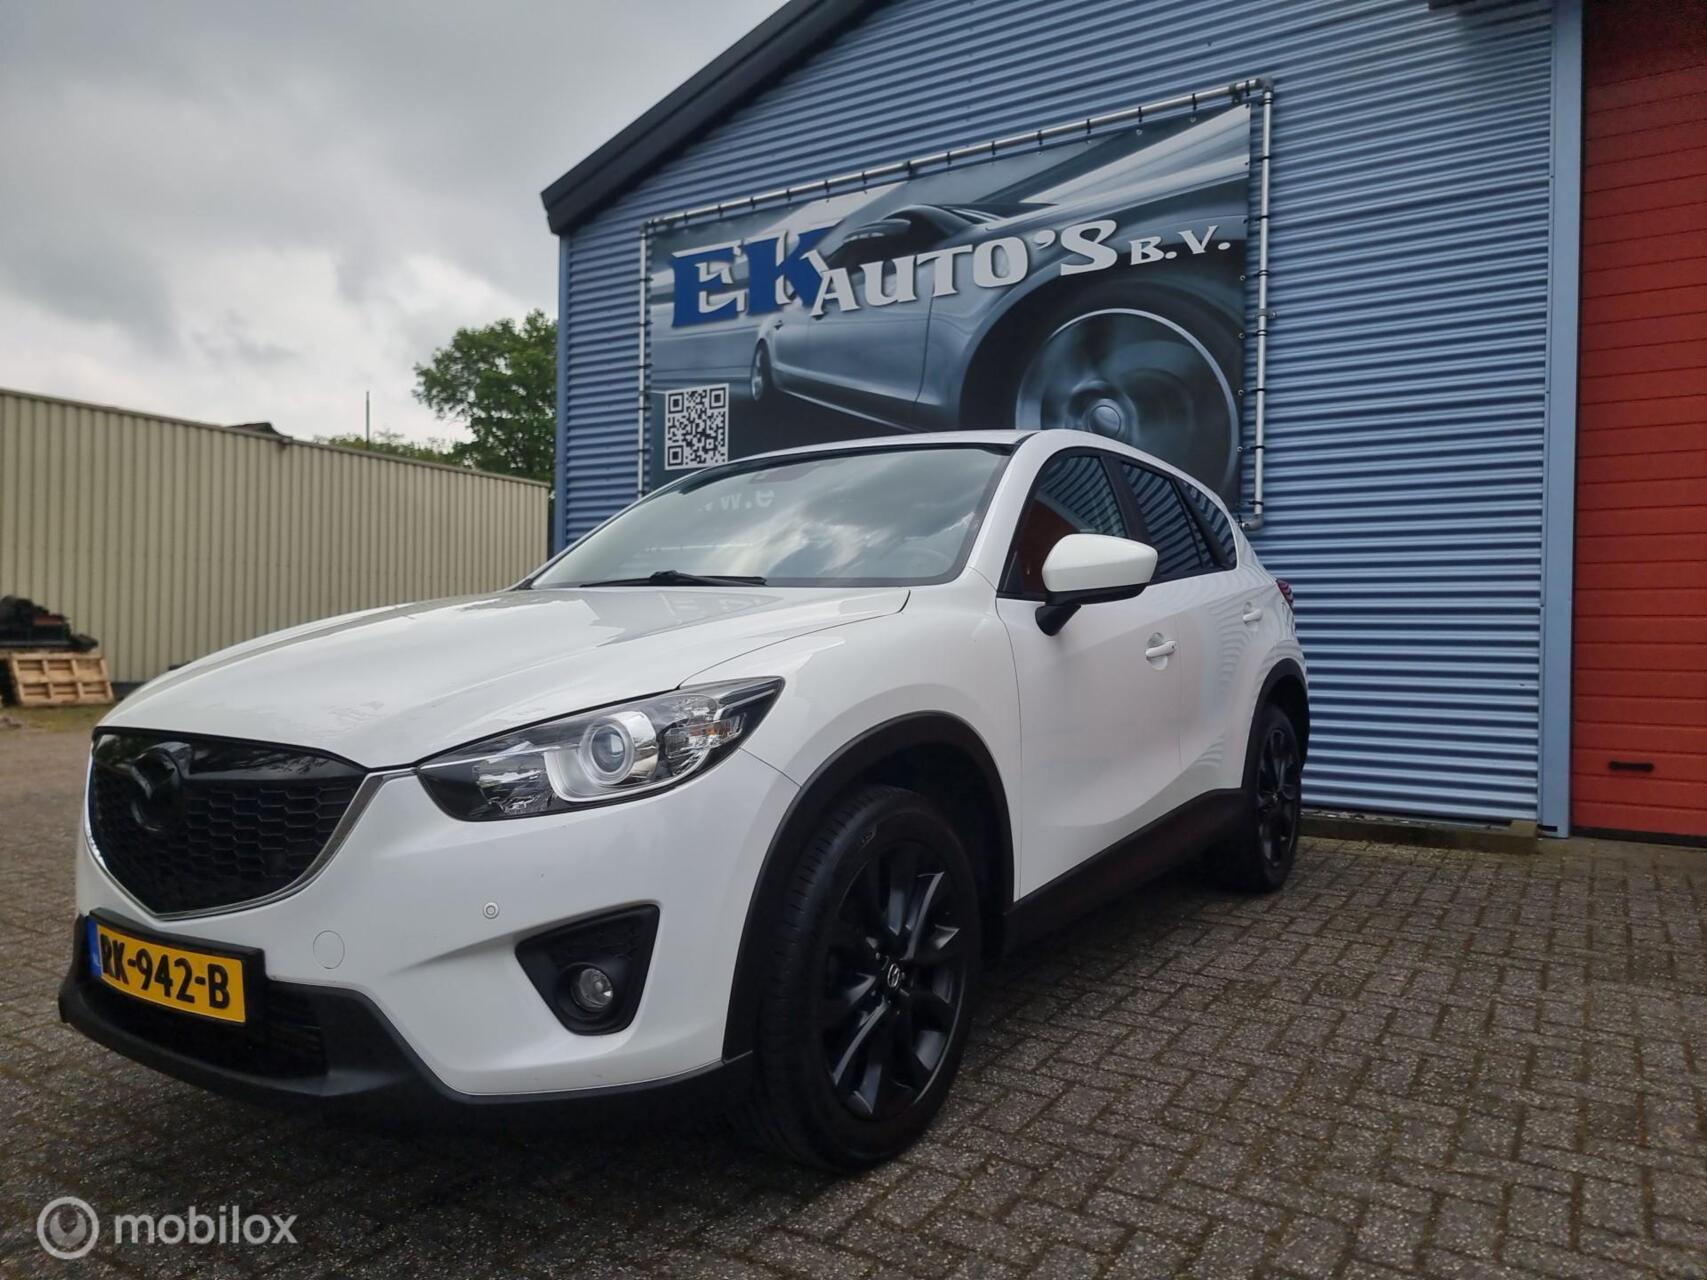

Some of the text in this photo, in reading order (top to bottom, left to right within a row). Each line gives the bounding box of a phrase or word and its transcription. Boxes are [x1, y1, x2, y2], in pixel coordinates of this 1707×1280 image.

[672, 219, 1231, 328] EK AUTO'S B.V.
[100, 933, 230, 1009] RK-942-B
